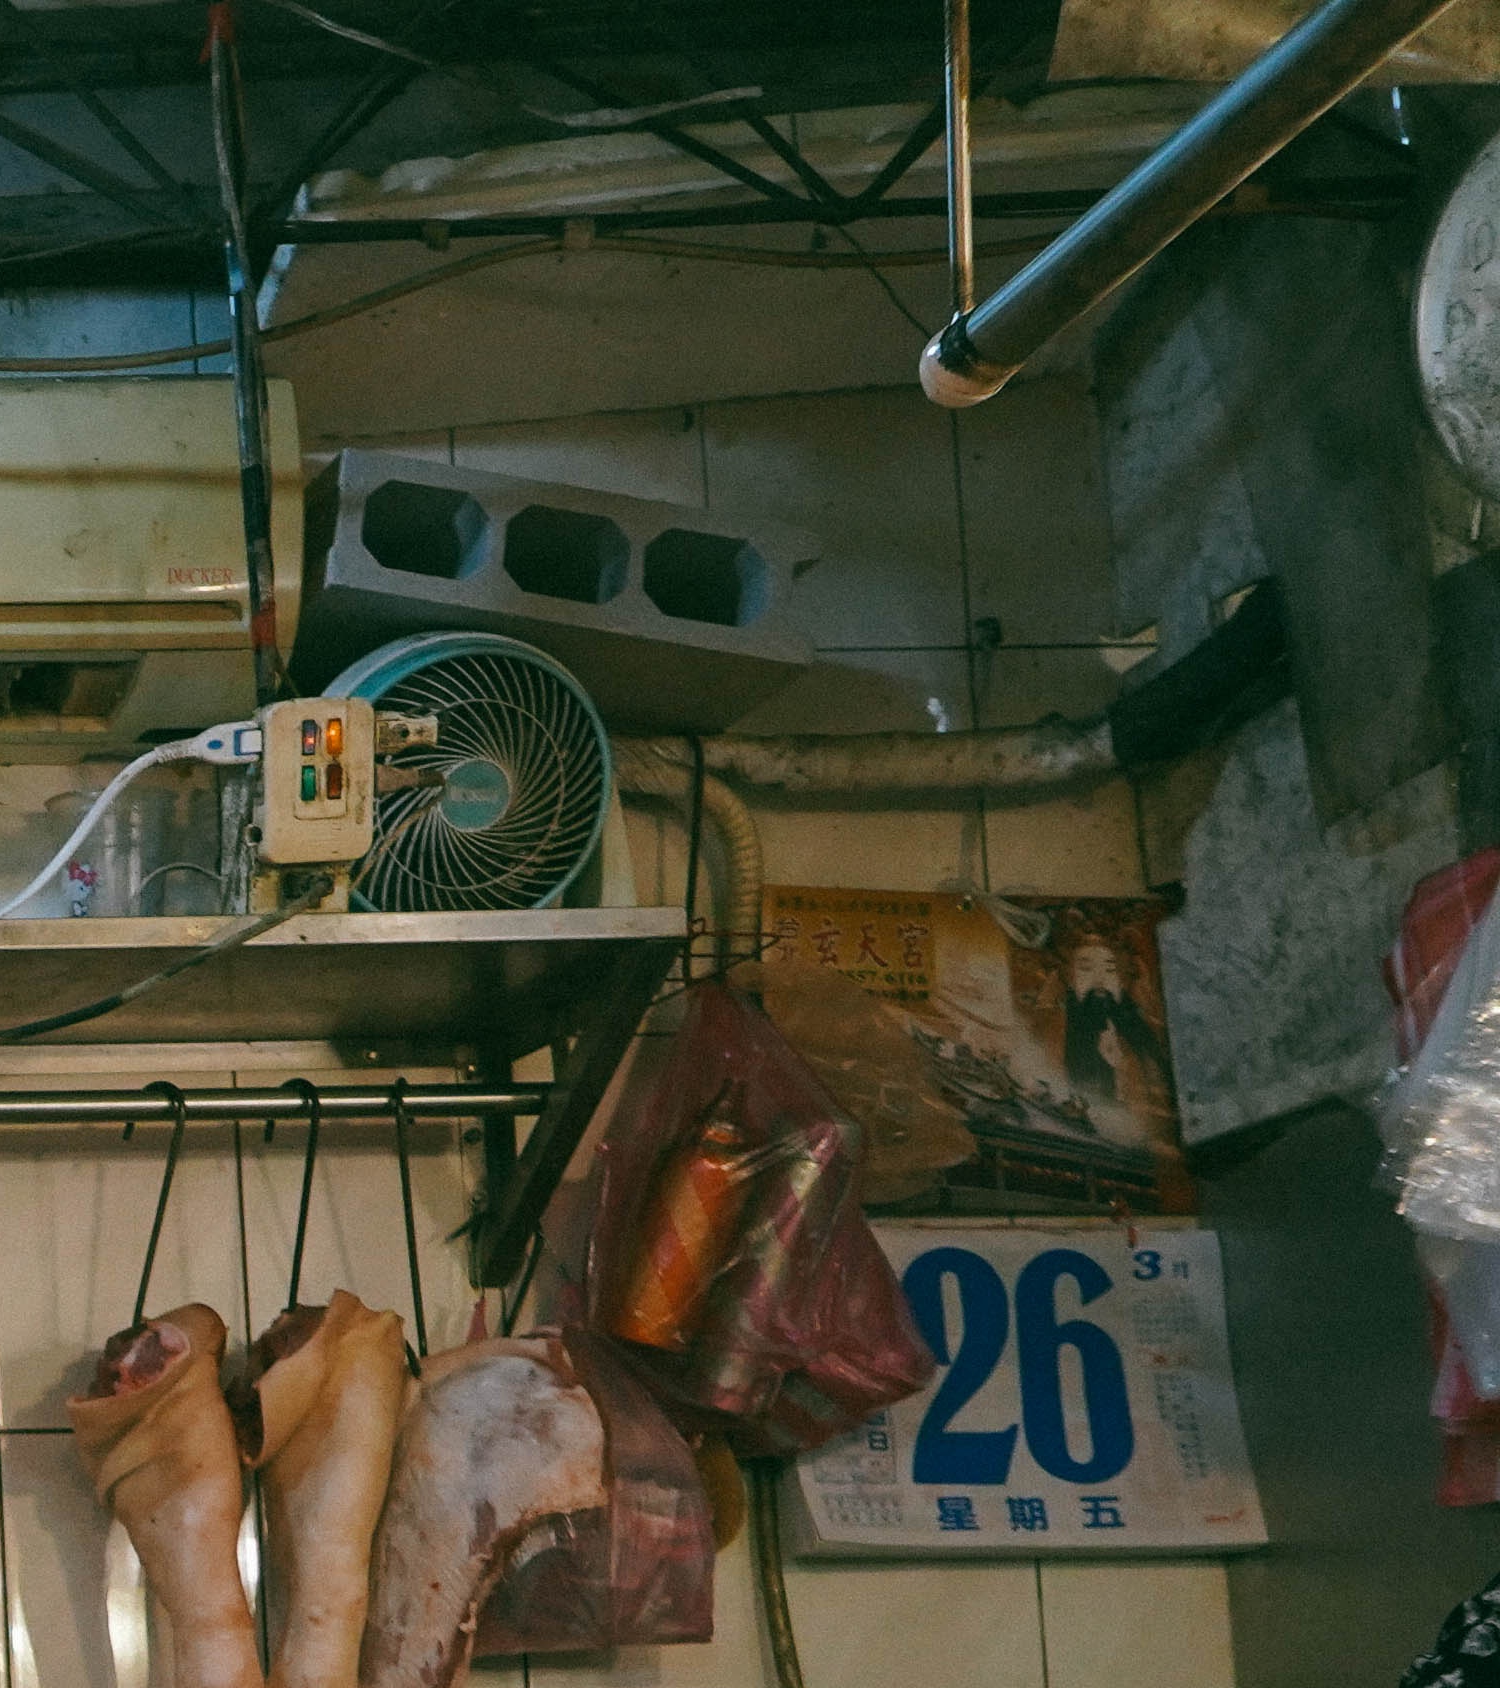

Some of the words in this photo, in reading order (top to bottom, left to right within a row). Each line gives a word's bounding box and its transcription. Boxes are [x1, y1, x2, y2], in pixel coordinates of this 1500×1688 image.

[902, 1246, 1135, 1486] 26
[936, 1495, 1127, 1532] 星期五
